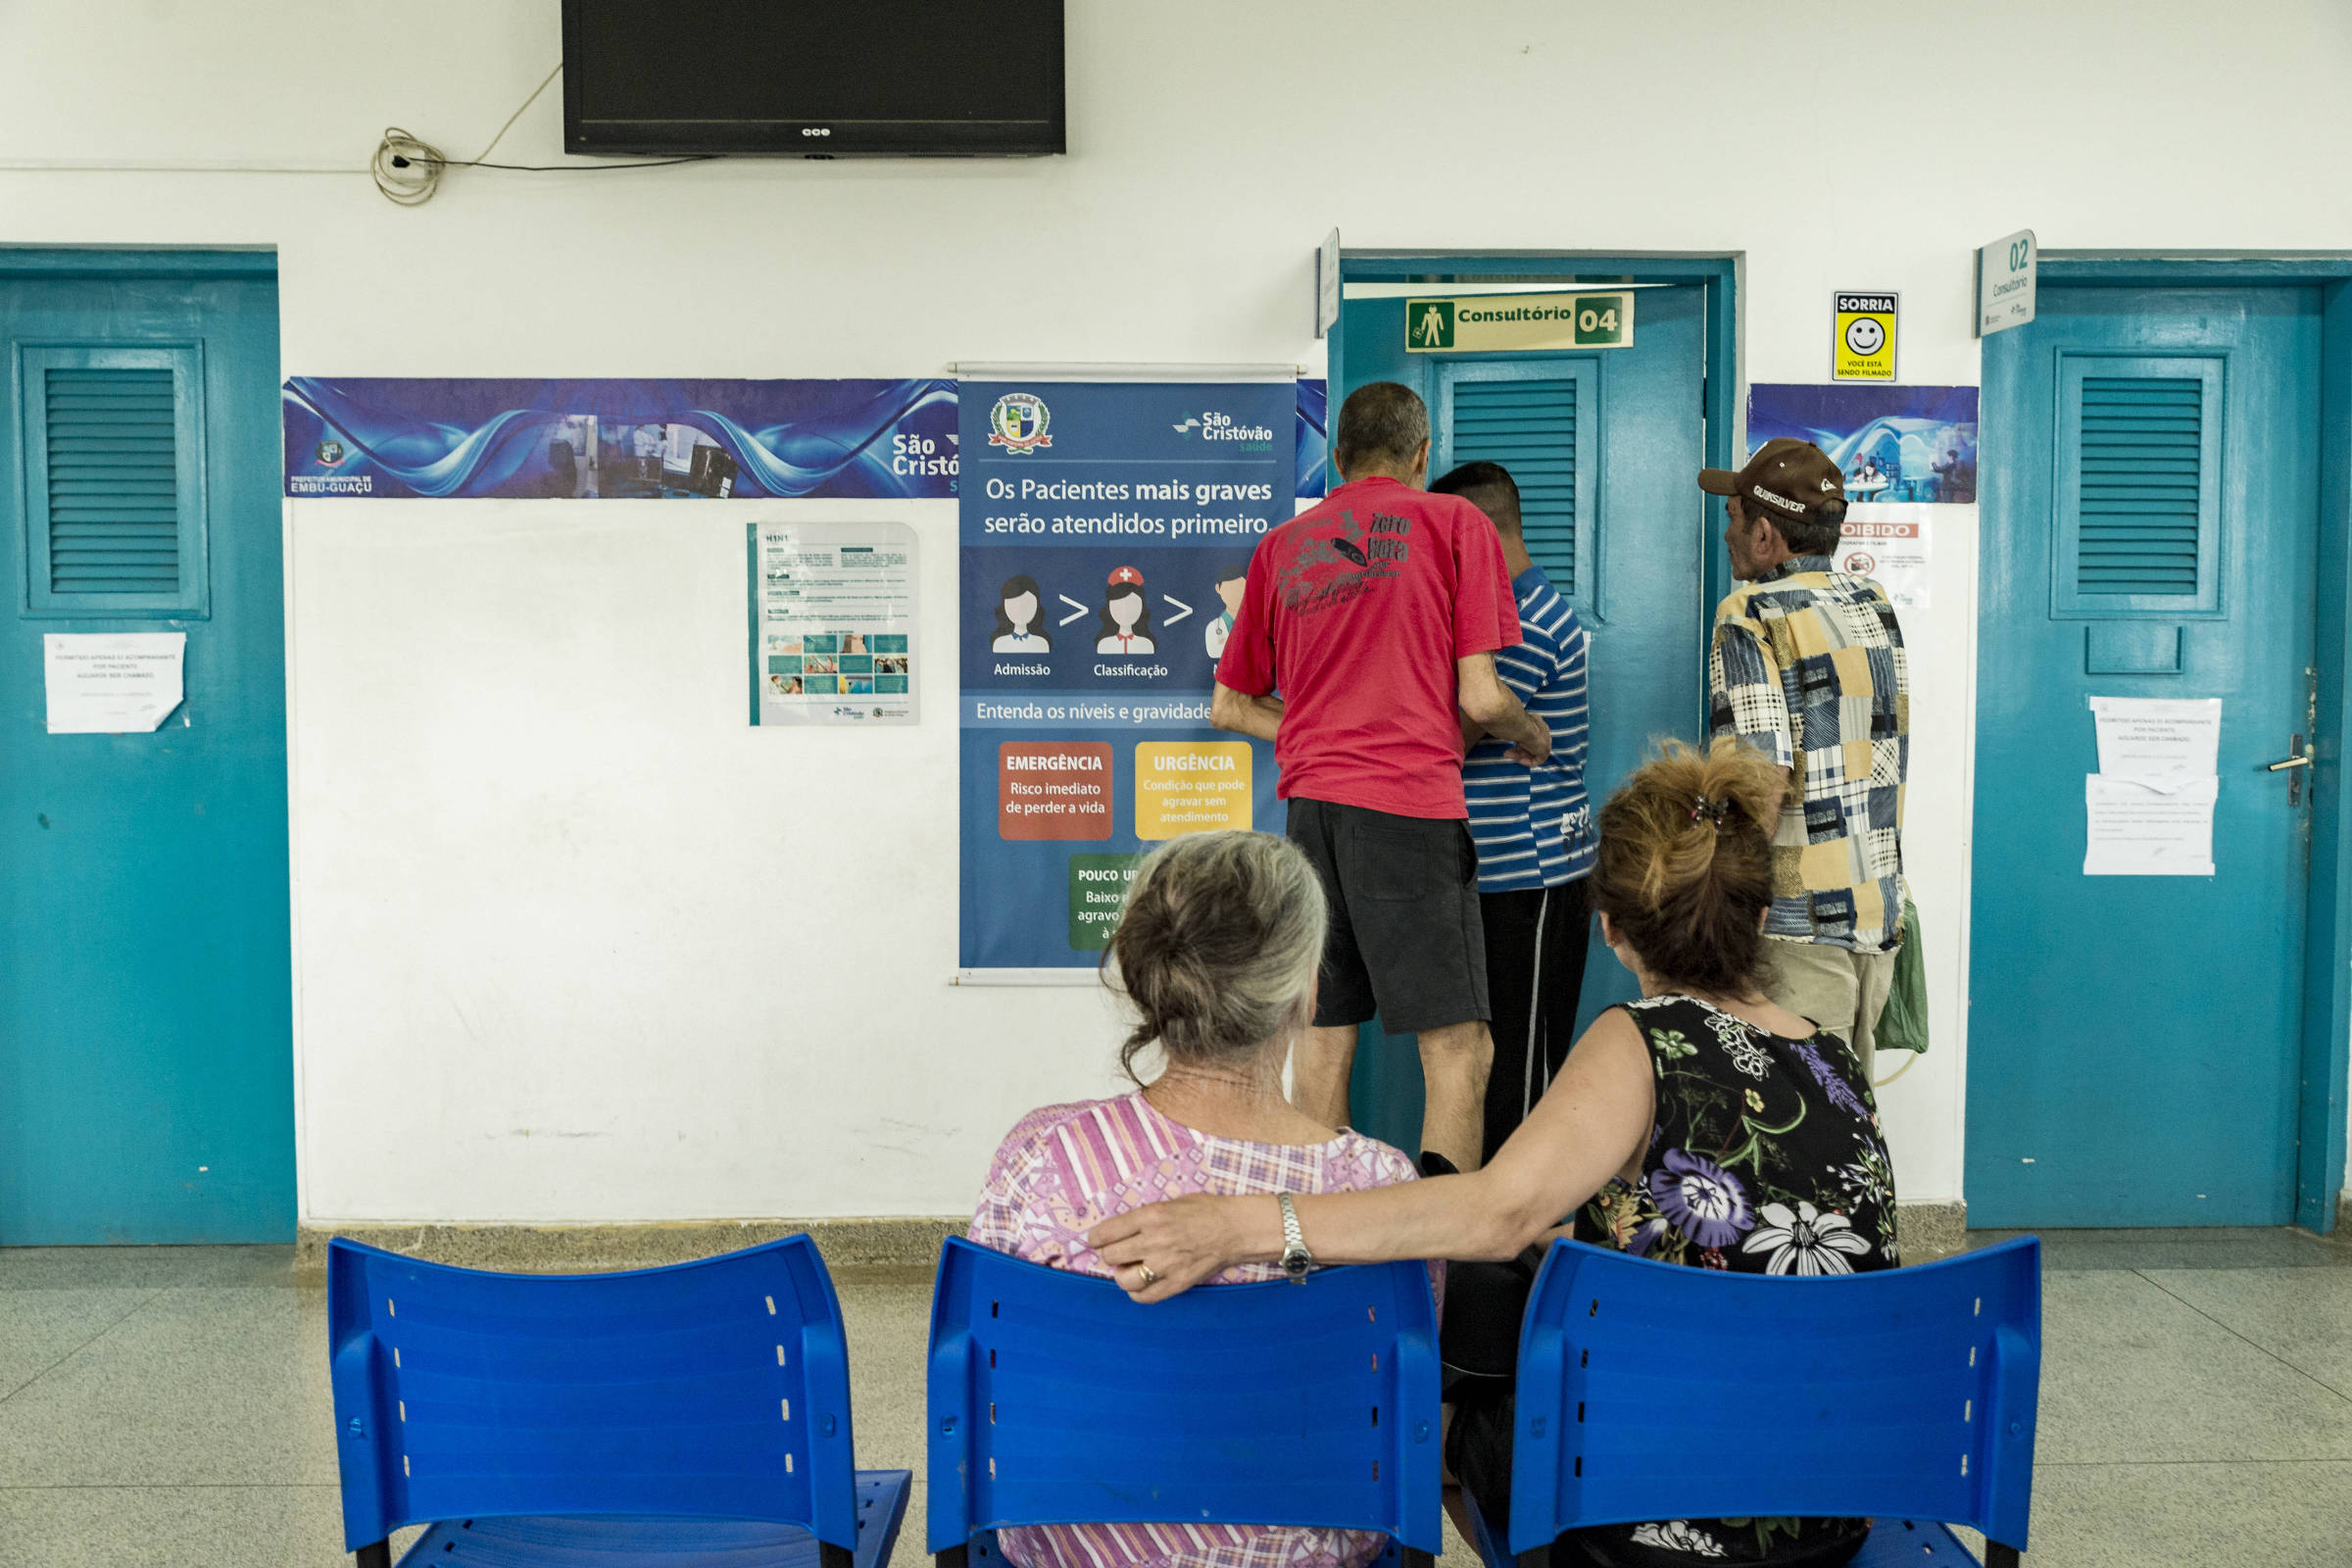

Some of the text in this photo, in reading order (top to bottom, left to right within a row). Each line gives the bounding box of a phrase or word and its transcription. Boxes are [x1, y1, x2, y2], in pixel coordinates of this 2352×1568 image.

[2010, 239, 2029, 272] 02
[1839, 298, 1893, 312] SORRIA
[1458, 306, 1618, 332] Consultório 04
[1202, 412, 1232, 426] São
[1202, 424, 1273, 441] Cristóvão
[892, 433, 936, 455] São
[893, 454, 959, 476] Cristó
[290, 482, 372, 495] EMBU-GUAÇU
[986, 478, 1272, 506] Os Pacientes mais graves
[984, 514, 1046, 535] serão
[1051, 513, 1165, 535] atendidos
[1841, 523, 1910, 536] OIBIDO
[994, 662, 1051, 677] Admissão
[1094, 663, 1168, 679] Classificação
[976, 702, 1043, 719] Entenda
[1047, 706, 1065, 719] os
[1069, 702, 1115, 719] níveis
[1118, 706, 1129, 719] e
[1006, 754, 1103, 770] EMERGÊNCIA
[1153, 753, 1235, 771] URGÊNCIA
[1010, 782, 1101, 795] Risco imediato
[1144, 779, 1246, 792] Condição que pode
[1005, 801, 1105, 815] de perder a vida
[1162, 798, 1226, 808] agravar sem
[1160, 811, 1229, 822] atendimento
[1078, 869, 1119, 881] POUCO
[1086, 891, 1119, 904] Baixo
[1078, 911, 1120, 923] agravo
[1102, 927, 1109, 939] à
